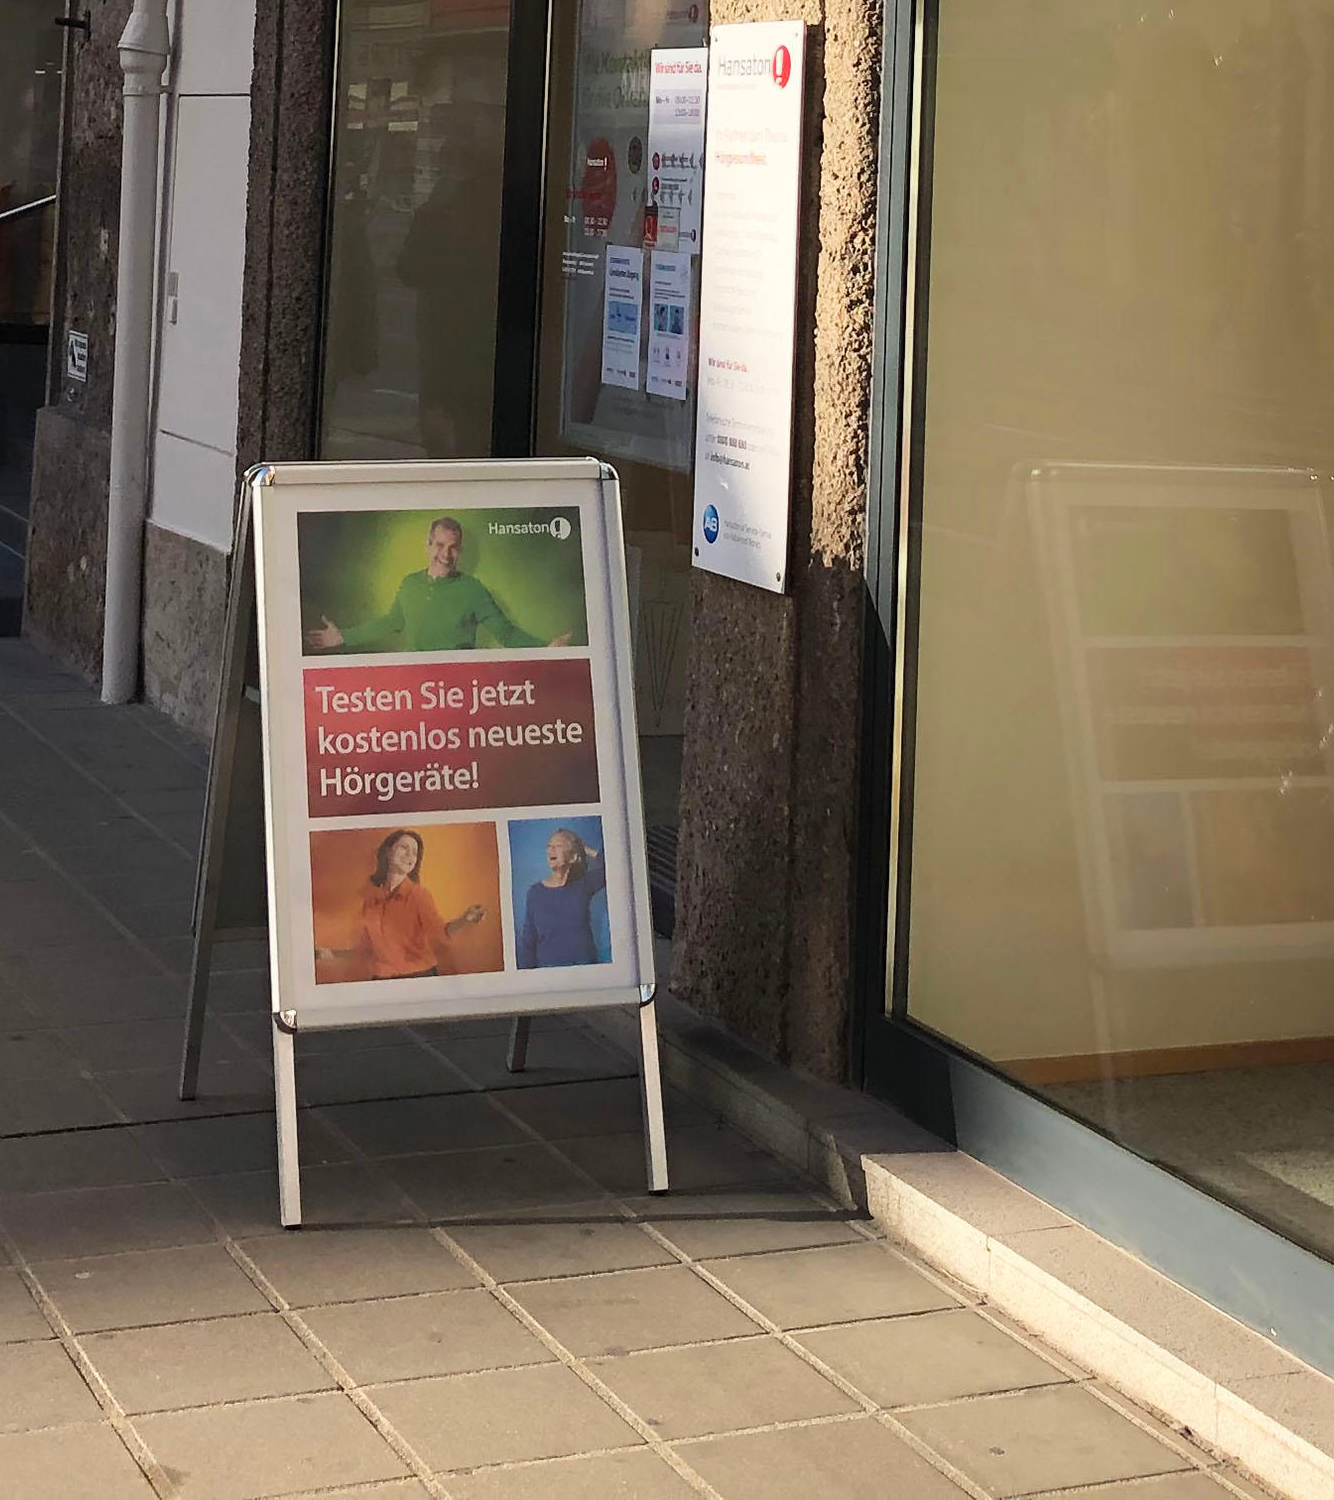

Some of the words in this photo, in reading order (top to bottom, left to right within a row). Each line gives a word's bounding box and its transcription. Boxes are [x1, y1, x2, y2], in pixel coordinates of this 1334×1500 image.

[718, 54, 771, 77] Hansaton
[488, 521, 549, 534] Hansaton
[315, 685, 413, 714] Testen
[420, 681, 464, 710] Sie
[469, 679, 536, 715] jetzt
[317, 721, 461, 755] kostenlos
[468, 718, 583, 749] neueste
[320, 761, 480, 802] Hörgeräte!
